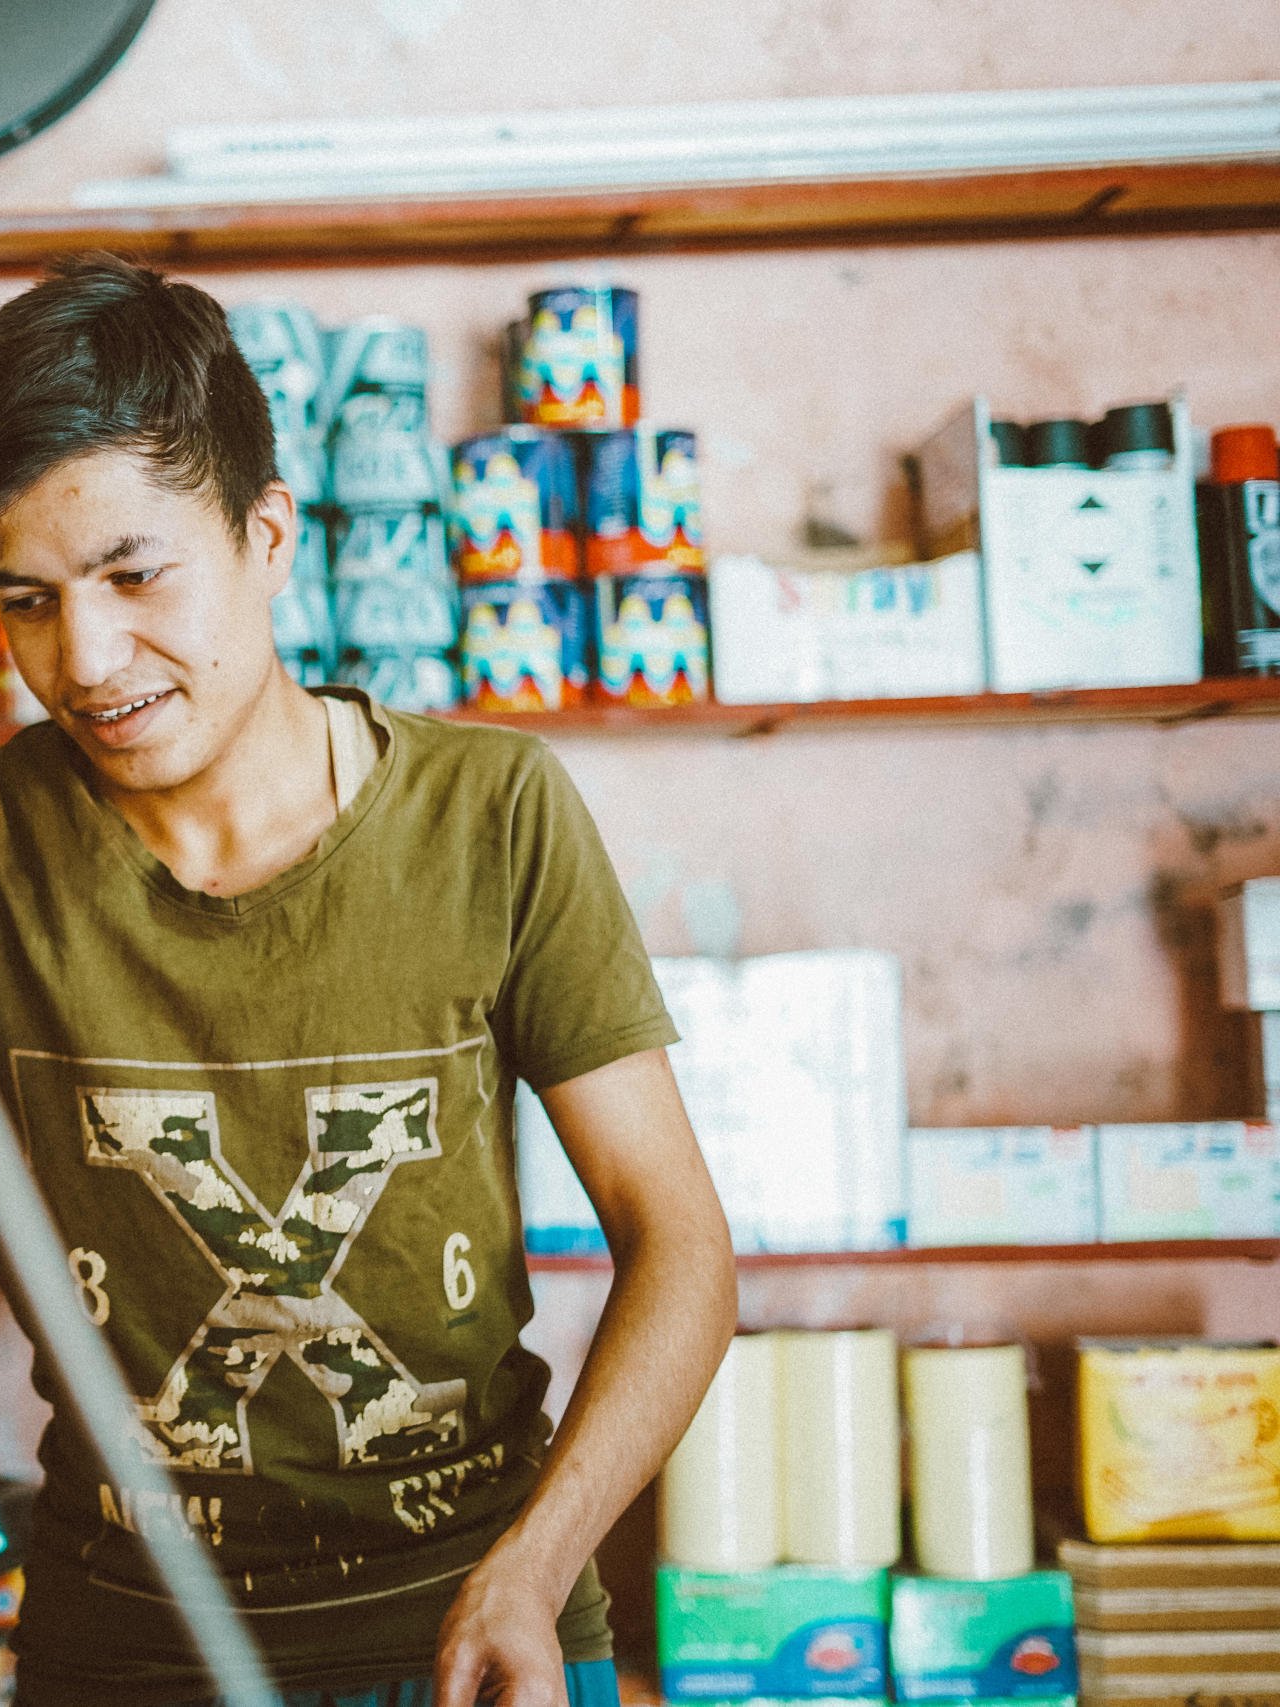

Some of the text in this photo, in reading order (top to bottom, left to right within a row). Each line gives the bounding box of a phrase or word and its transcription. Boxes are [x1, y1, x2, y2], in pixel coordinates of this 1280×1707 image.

[68, 1247, 110, 1326] 8
[77, 1078, 468, 1476] X
[443, 1232, 476, 1310] 6
